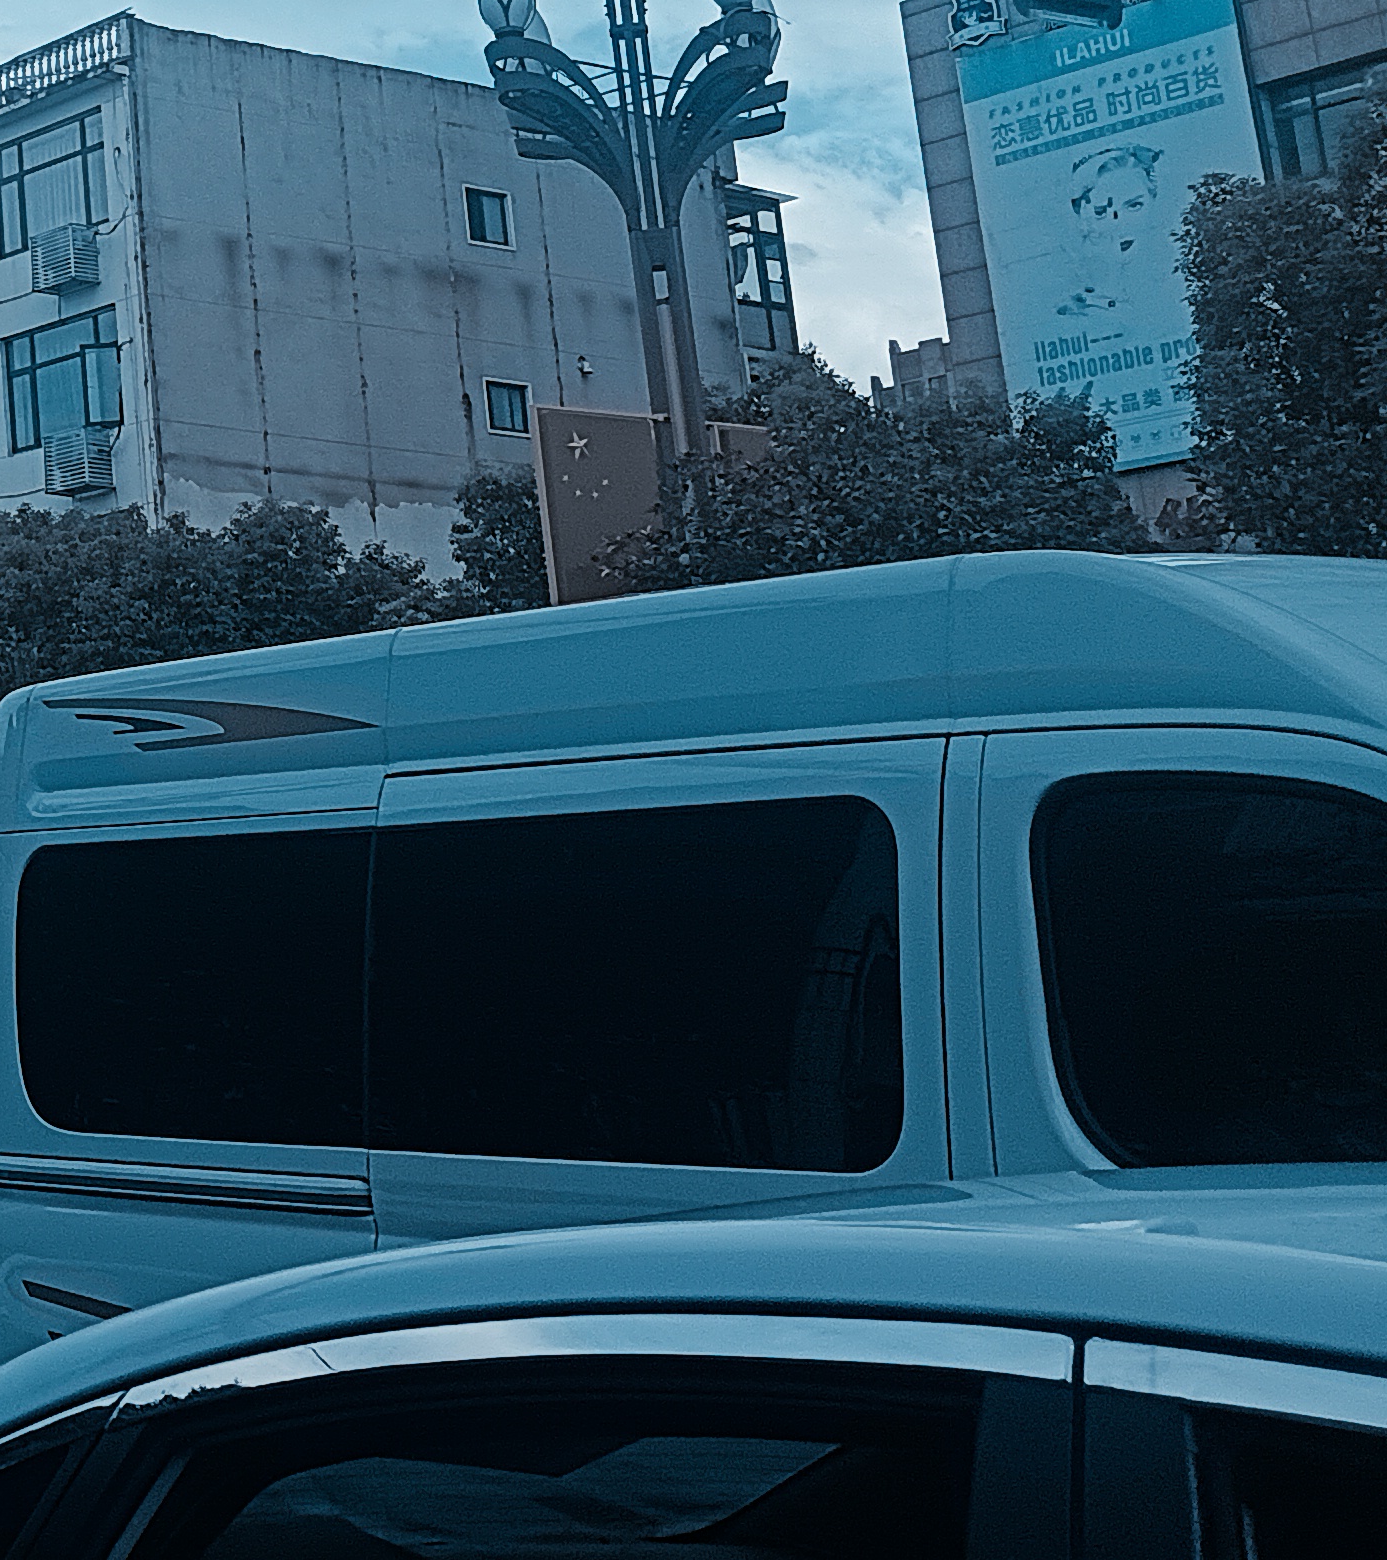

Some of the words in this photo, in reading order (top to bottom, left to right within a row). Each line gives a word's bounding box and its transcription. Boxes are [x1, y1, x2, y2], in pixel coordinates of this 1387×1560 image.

[1055, 28, 1131, 68] ILAHUI
[988, 84, 1082, 120] FASHION
[1097, 44, 1216, 89] PRODUCTS
[1106, 61, 1223, 117] 时尚百货
[1037, 345, 1155, 387] fashionable
